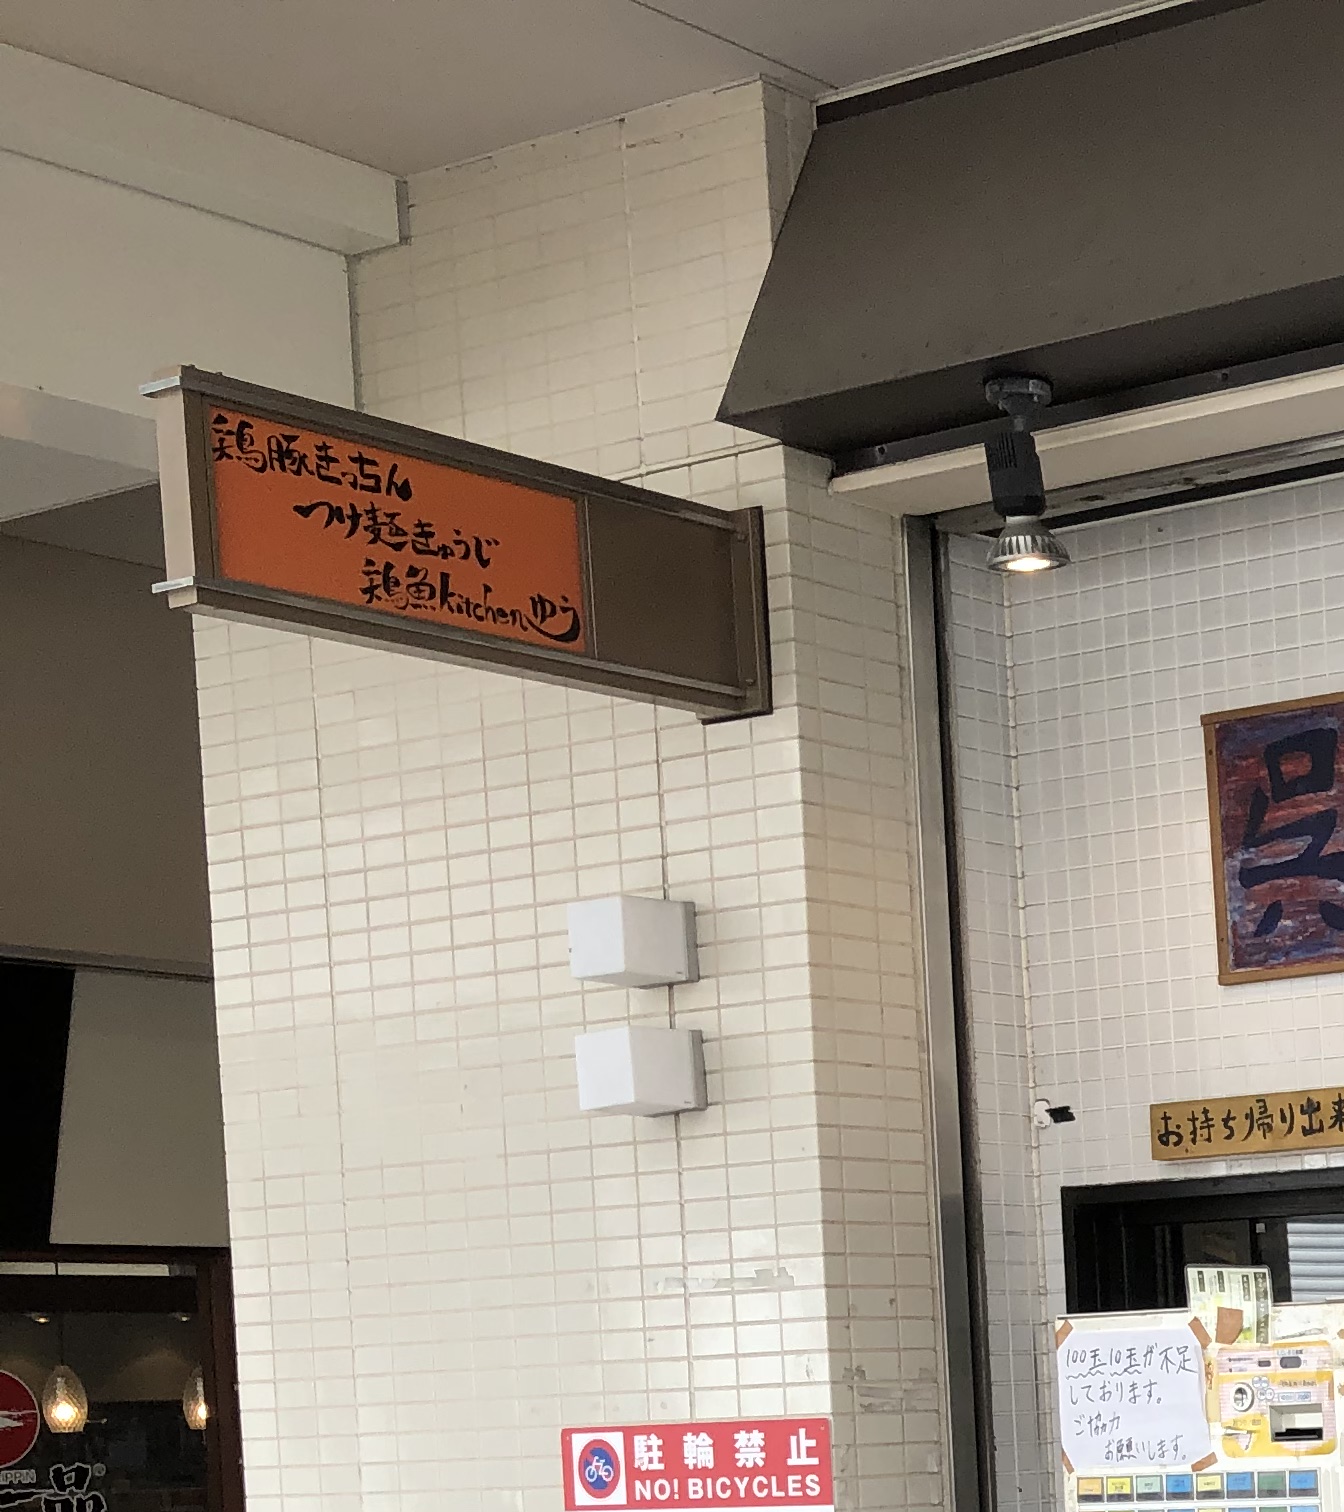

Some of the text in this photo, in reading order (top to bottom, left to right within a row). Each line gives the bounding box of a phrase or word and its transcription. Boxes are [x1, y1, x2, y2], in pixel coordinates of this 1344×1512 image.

[210, 413, 413, 502] 鶏豚きっちん
[293, 501, 501, 569] つけ麺きゅうじ
[1074, 1412, 1120, 1437] ご協力
[633, 1428, 820, 1471] 駐輪禁止
[634, 1474, 821, 1501] NO! BICYCLES
